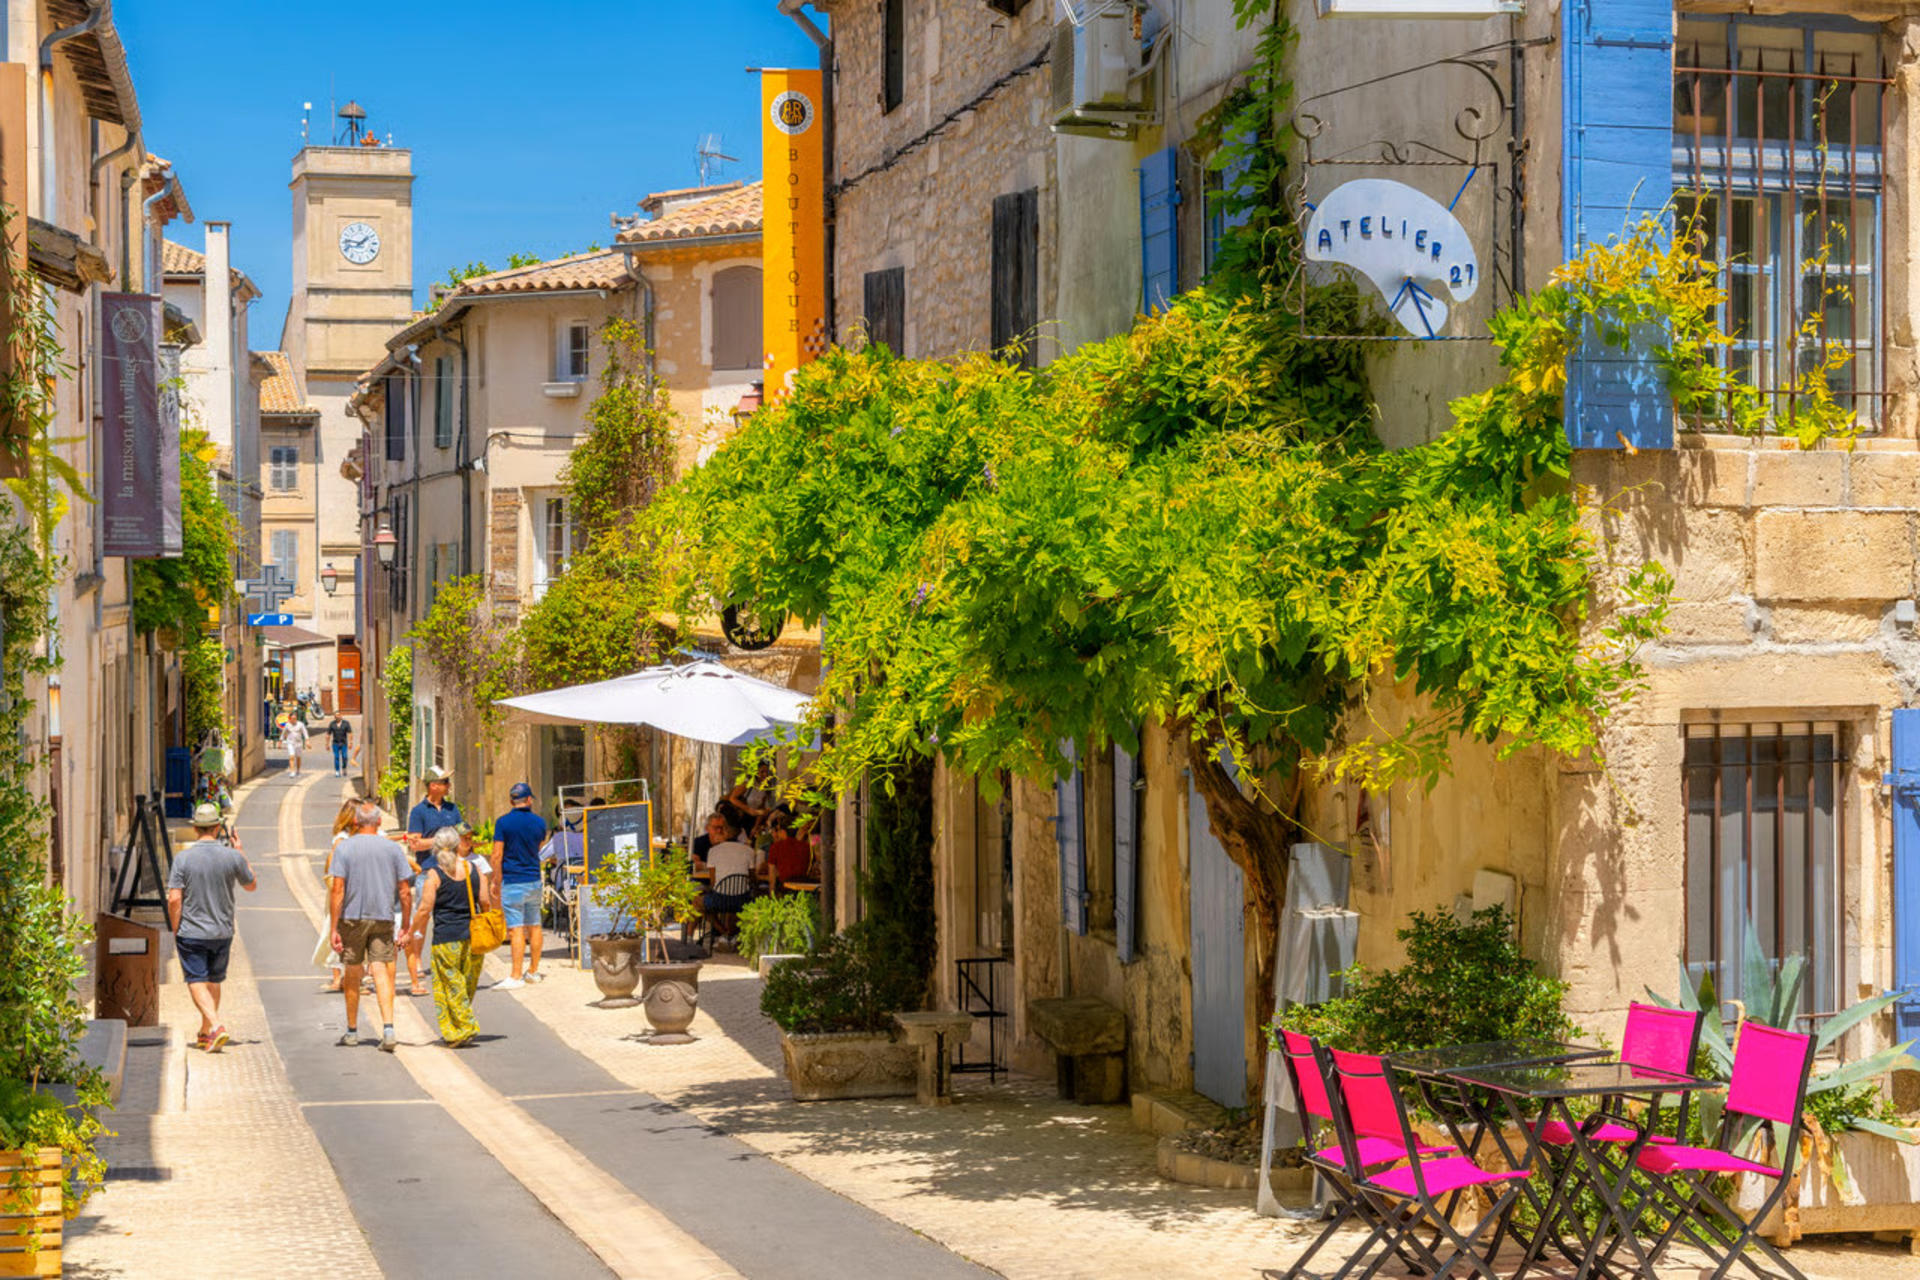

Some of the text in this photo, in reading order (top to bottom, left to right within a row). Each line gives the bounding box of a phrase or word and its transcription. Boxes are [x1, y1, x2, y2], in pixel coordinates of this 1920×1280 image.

[787, 148, 800, 332] BOUTIQUE
[1318, 215, 1474, 284] ATELIER 27
[120, 355, 138, 401] village
[118, 405, 135, 425] du
[121, 428, 135, 481] maison
[117, 485, 134, 498] la
[279, 614, 288, 625] P
